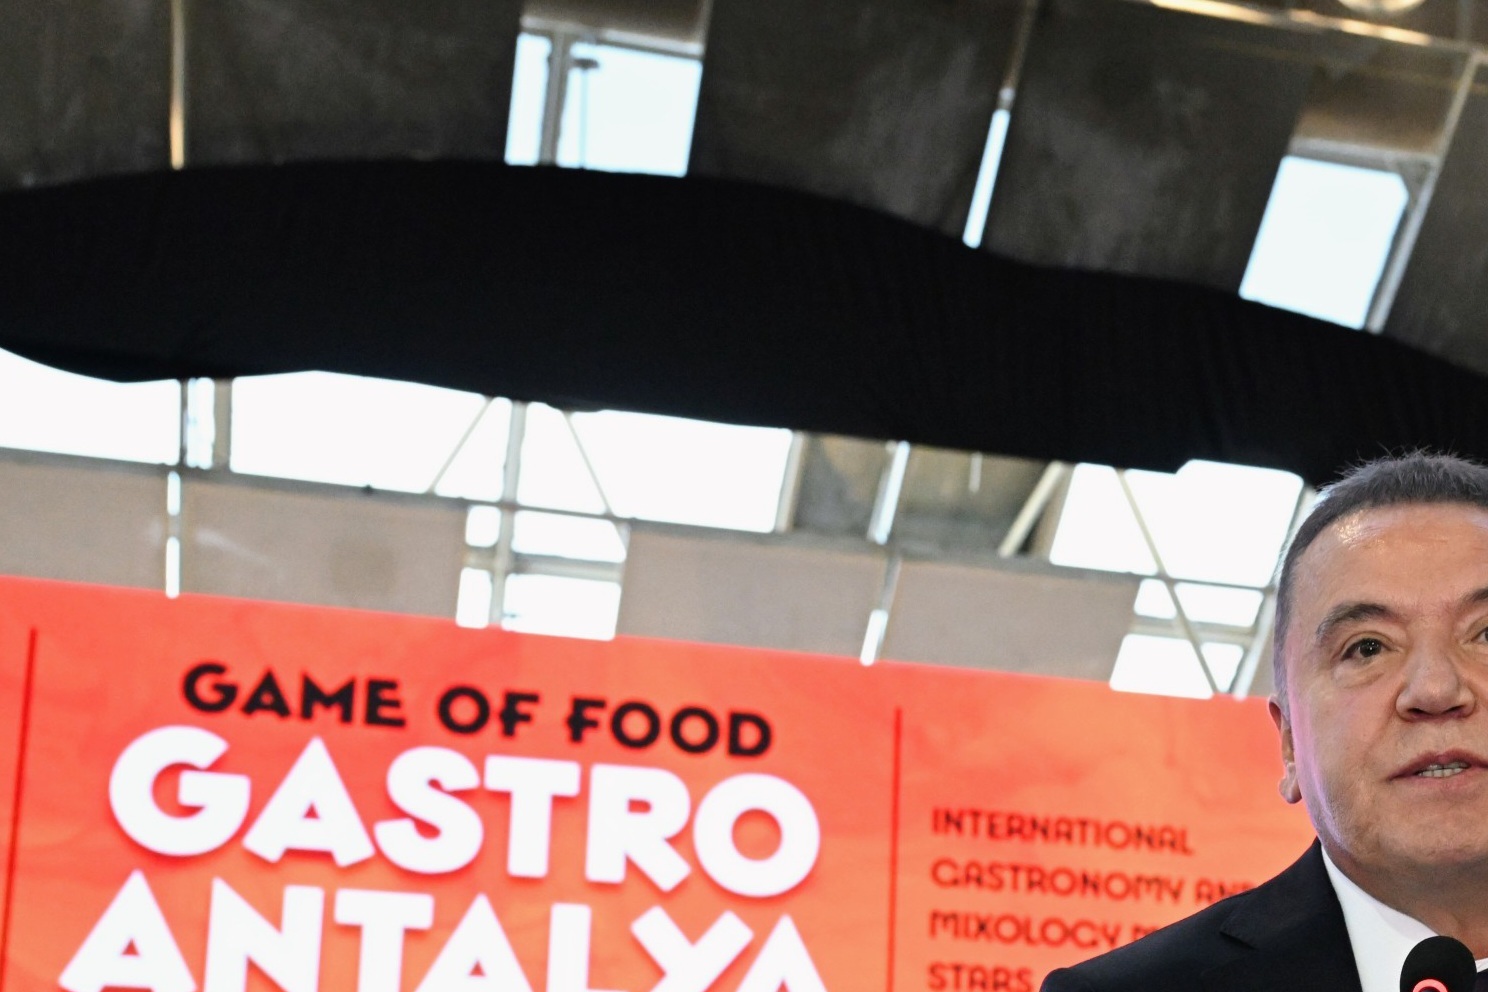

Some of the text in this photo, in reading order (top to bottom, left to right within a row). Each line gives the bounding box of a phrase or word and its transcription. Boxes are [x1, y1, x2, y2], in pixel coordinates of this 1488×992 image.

[182, 663, 774, 756] GAME OF FOOD
[108, 725, 822, 896] GASTRO
[930, 807, 1194, 856] INTERNATIONAL
[931, 857, 1185, 905] GASTRONOMY
[929, 908, 1123, 951] MIXOLOGY
